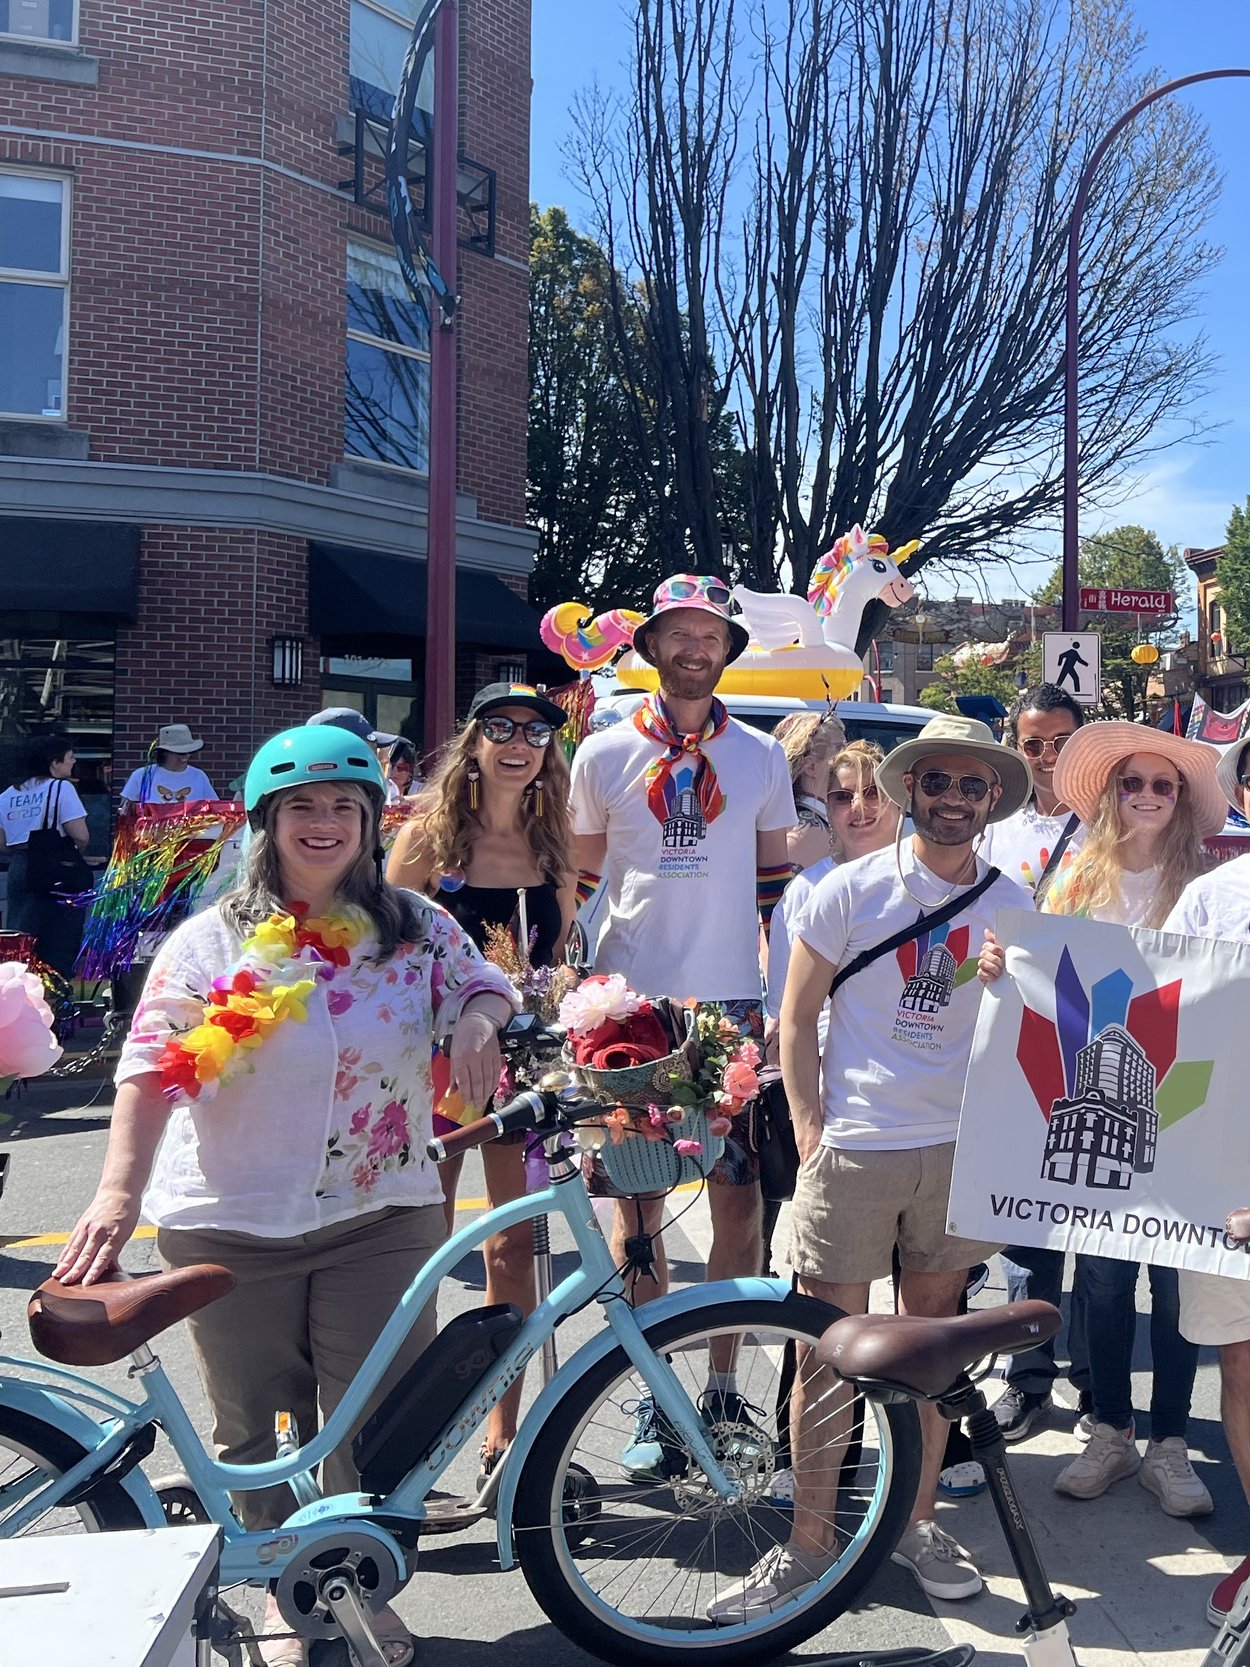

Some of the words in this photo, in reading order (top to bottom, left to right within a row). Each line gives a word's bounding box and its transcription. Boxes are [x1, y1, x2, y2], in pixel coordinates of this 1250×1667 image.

[1111, 592, 1166, 609] Herald
[10, 792, 44, 808] TEAM
[897, 1009, 935, 1022] VICTORIA
[895, 1018, 944, 1032] DOWNTOWN
[990, 1194, 1114, 1232] VICTORIA
